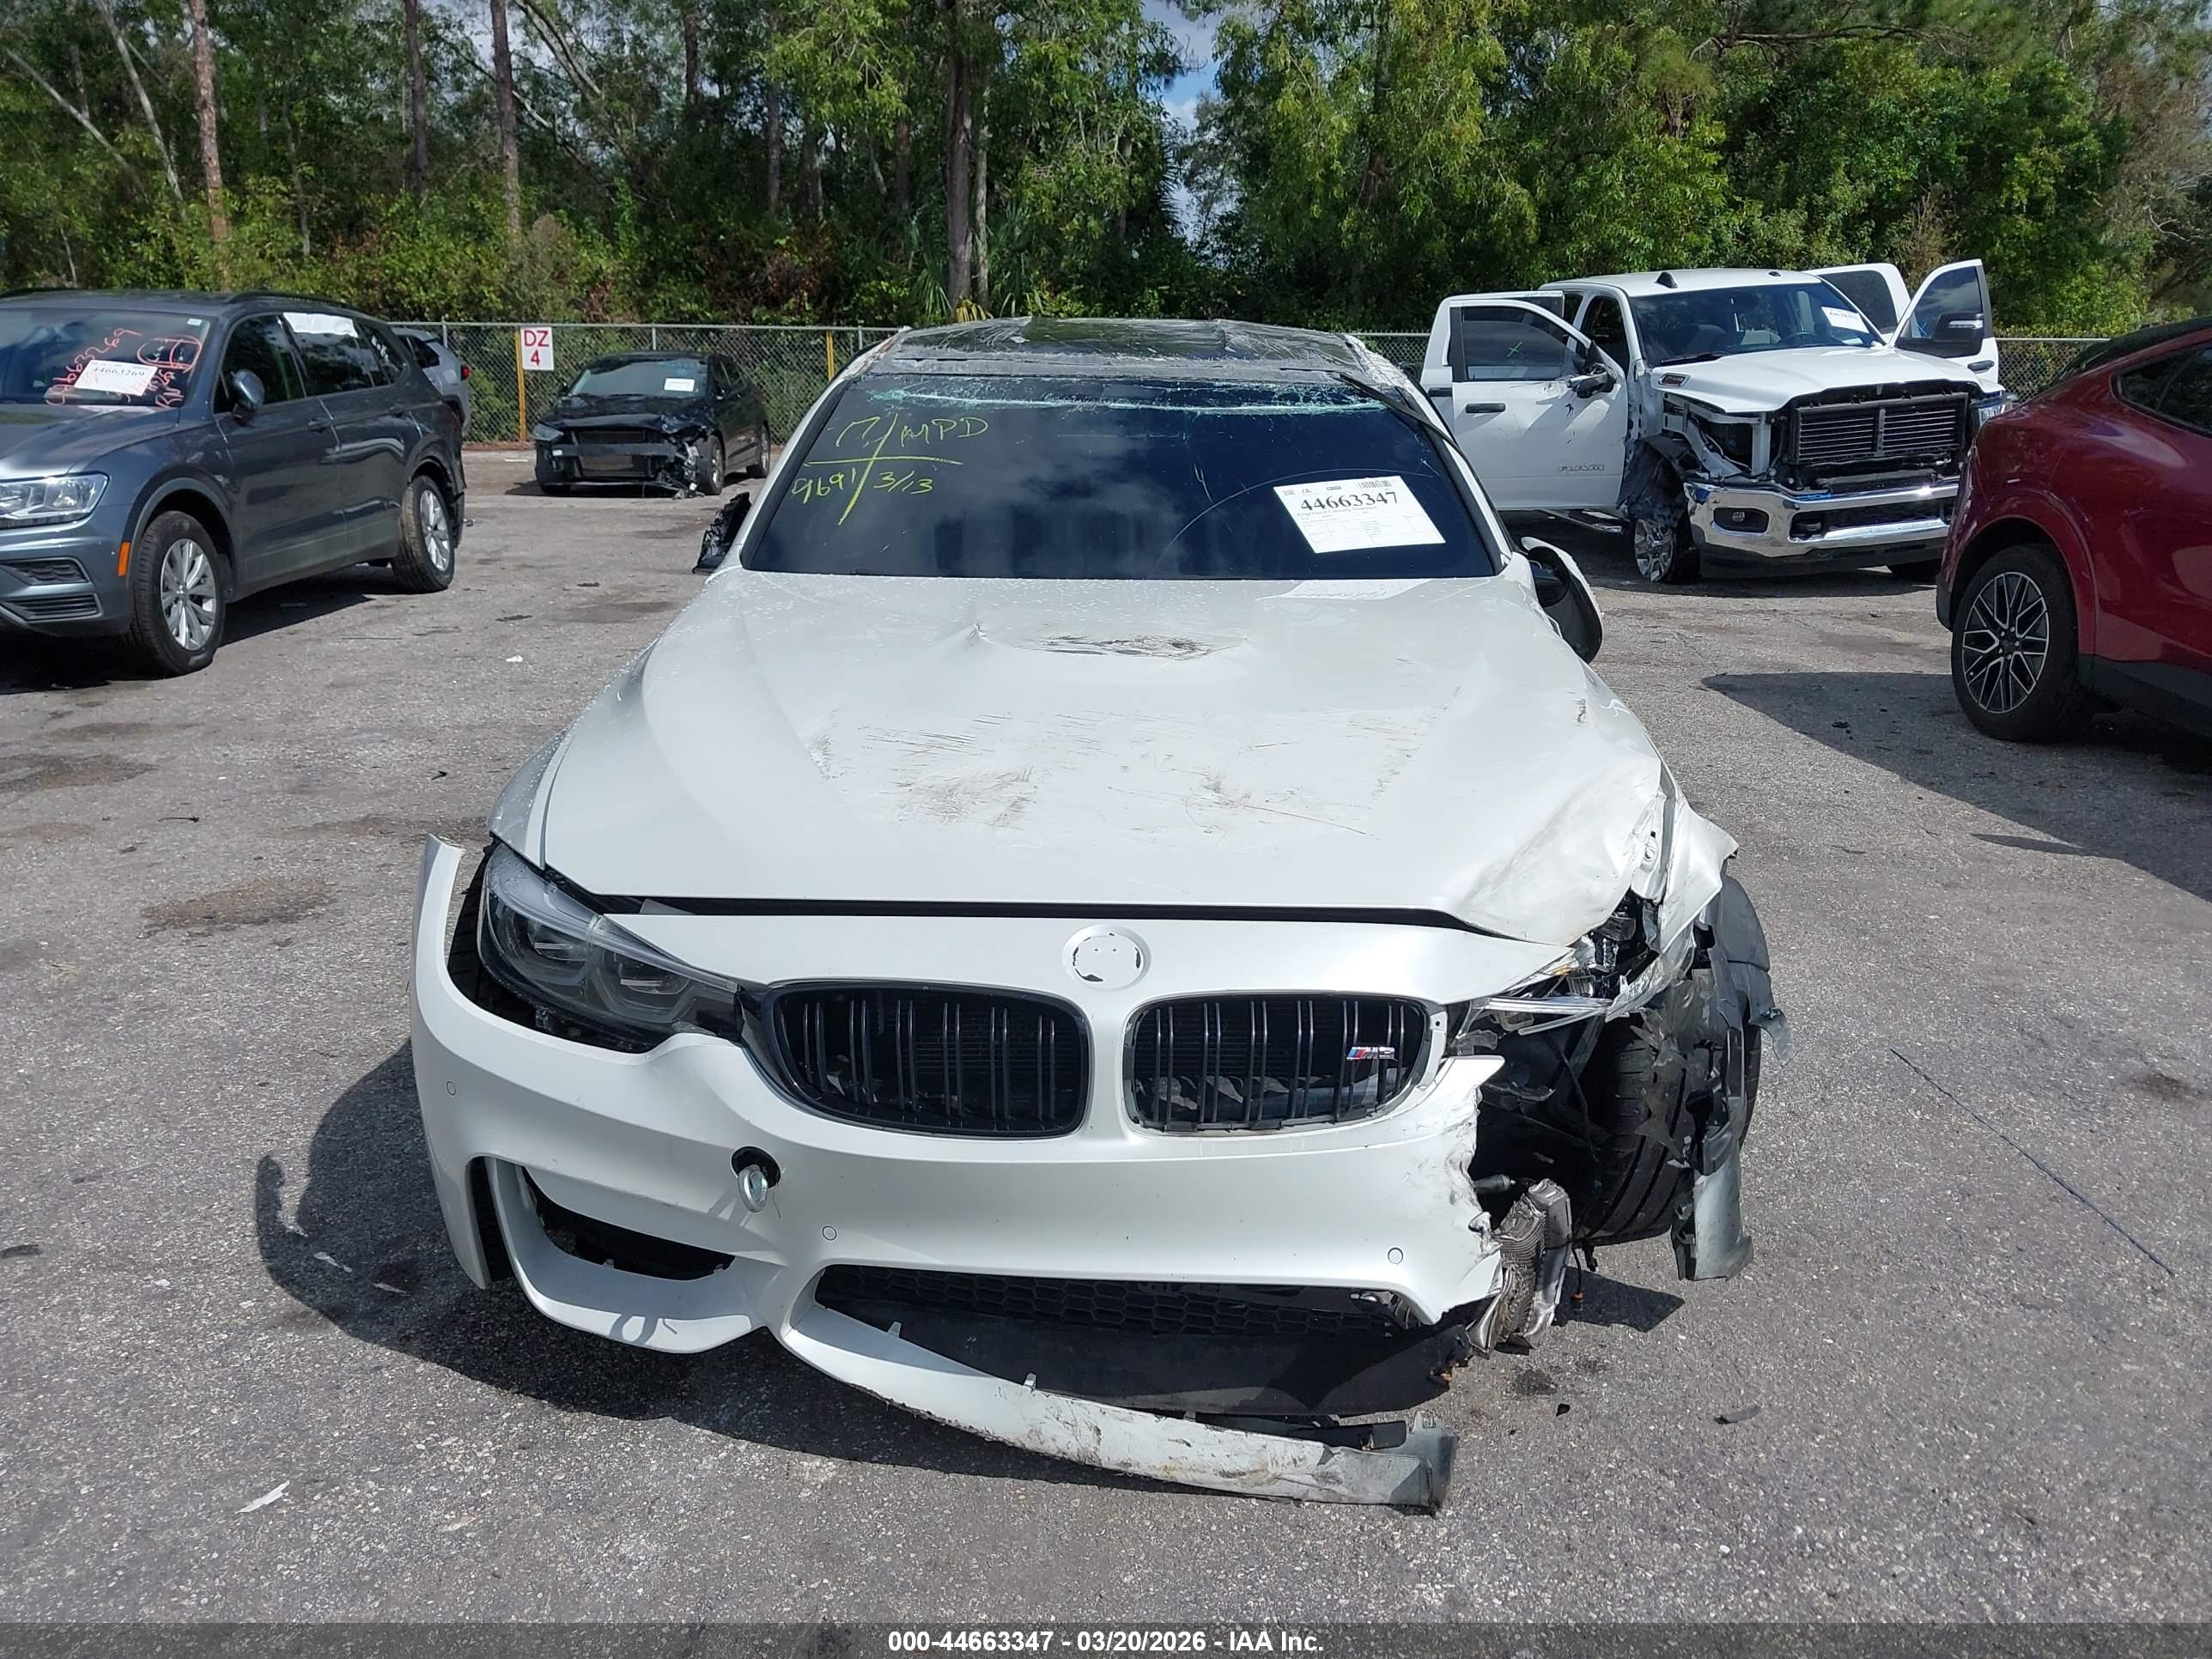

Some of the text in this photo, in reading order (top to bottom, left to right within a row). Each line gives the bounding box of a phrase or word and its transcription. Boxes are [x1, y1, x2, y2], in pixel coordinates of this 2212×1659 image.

[524, 330, 550, 347] DZ
[530, 349, 541, 366] 4
[1300, 491, 1398, 511] 44663347
